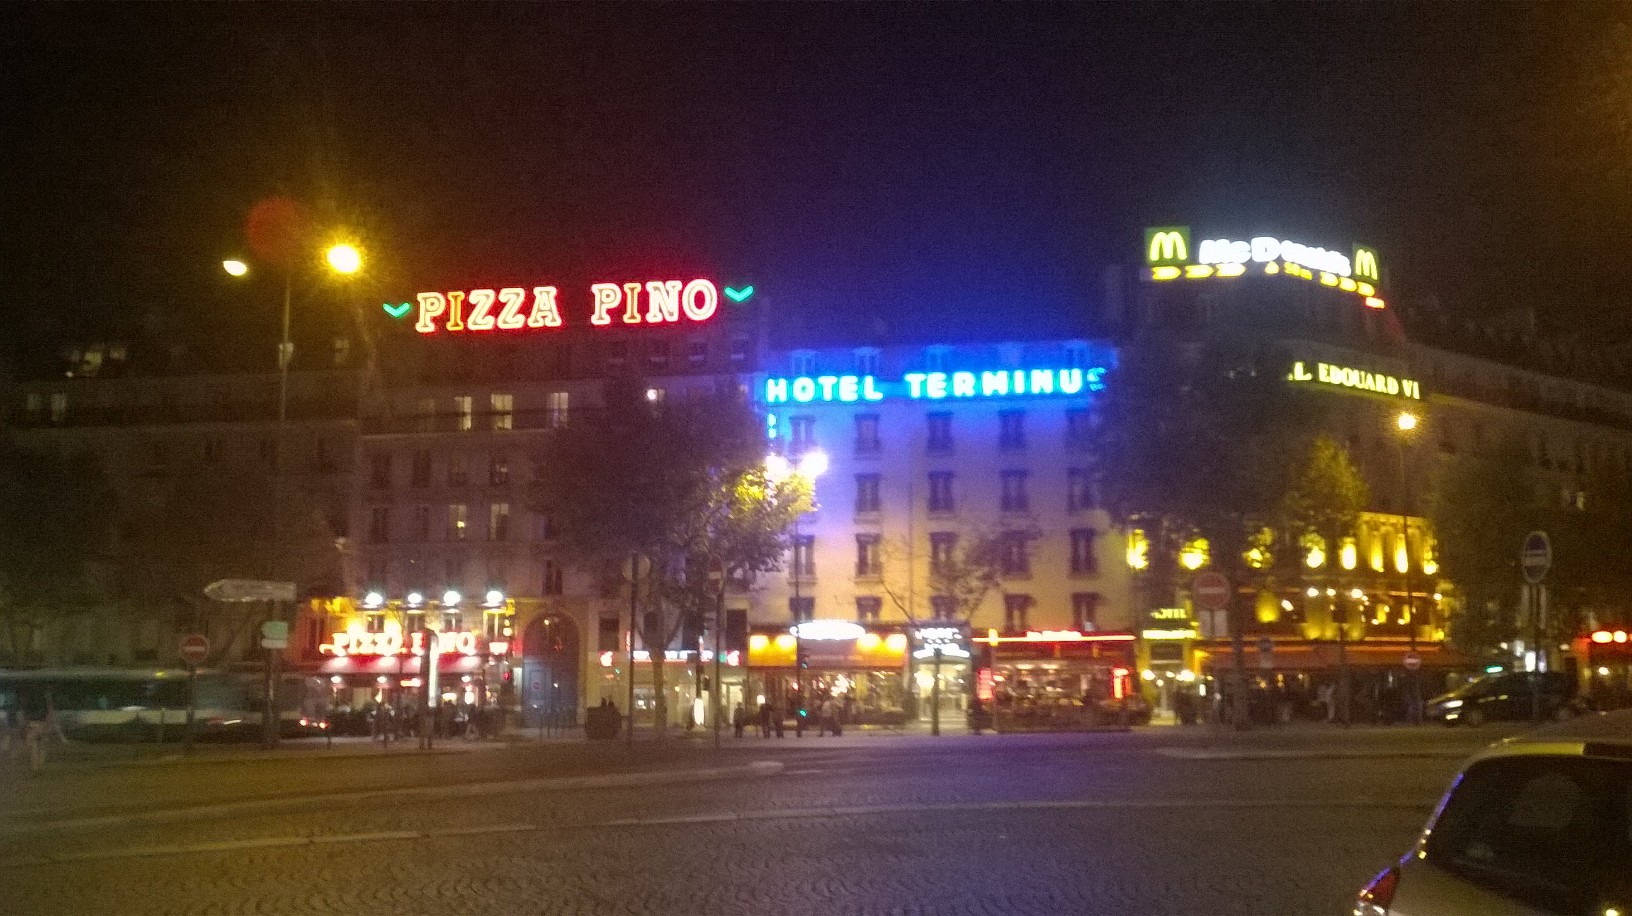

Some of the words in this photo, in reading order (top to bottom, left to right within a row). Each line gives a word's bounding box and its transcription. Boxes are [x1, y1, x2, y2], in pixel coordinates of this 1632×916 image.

[415, 285, 562, 333] PIZZA
[590, 278, 718, 326] PINO
[765, 375, 884, 403] HOTEL
[1317, 362, 1399, 395] EDOUARD
